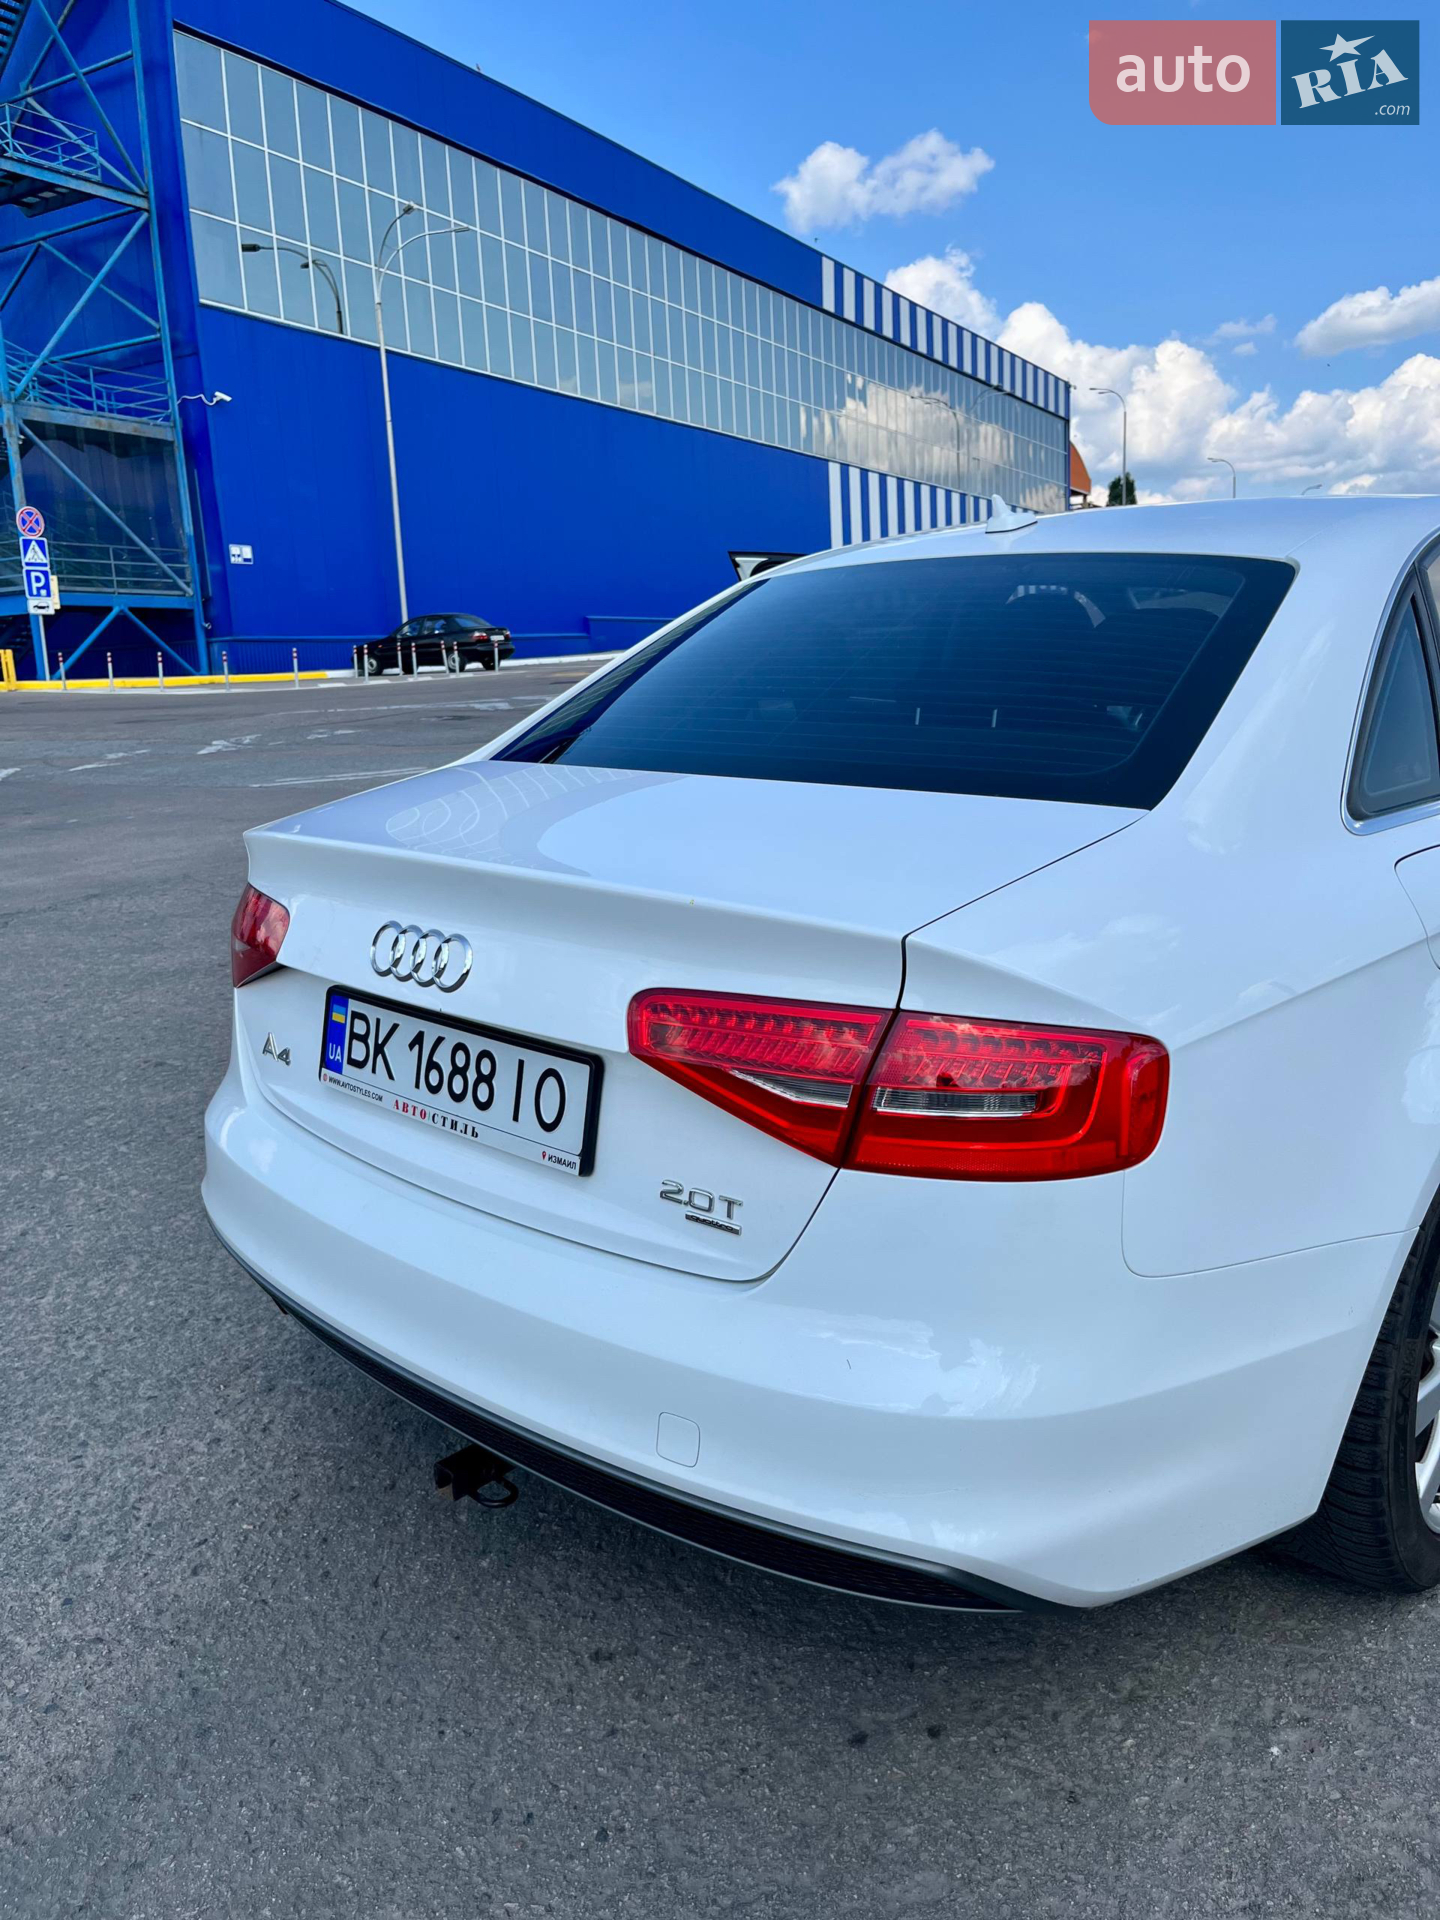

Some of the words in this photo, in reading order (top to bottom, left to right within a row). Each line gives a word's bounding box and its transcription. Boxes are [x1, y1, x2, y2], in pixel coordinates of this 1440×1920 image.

[30, 571, 46, 596] P
[262, 1031, 291, 1066] A4
[328, 1042, 342, 1063] UA
[347, 1010, 400, 1081] BK
[407, 1030, 497, 1112] 1688
[328, 1075, 384, 1103] WWW.AVTOSTYLES.COM
[547, 1153, 577, 1170] ИЗМАИЛ
